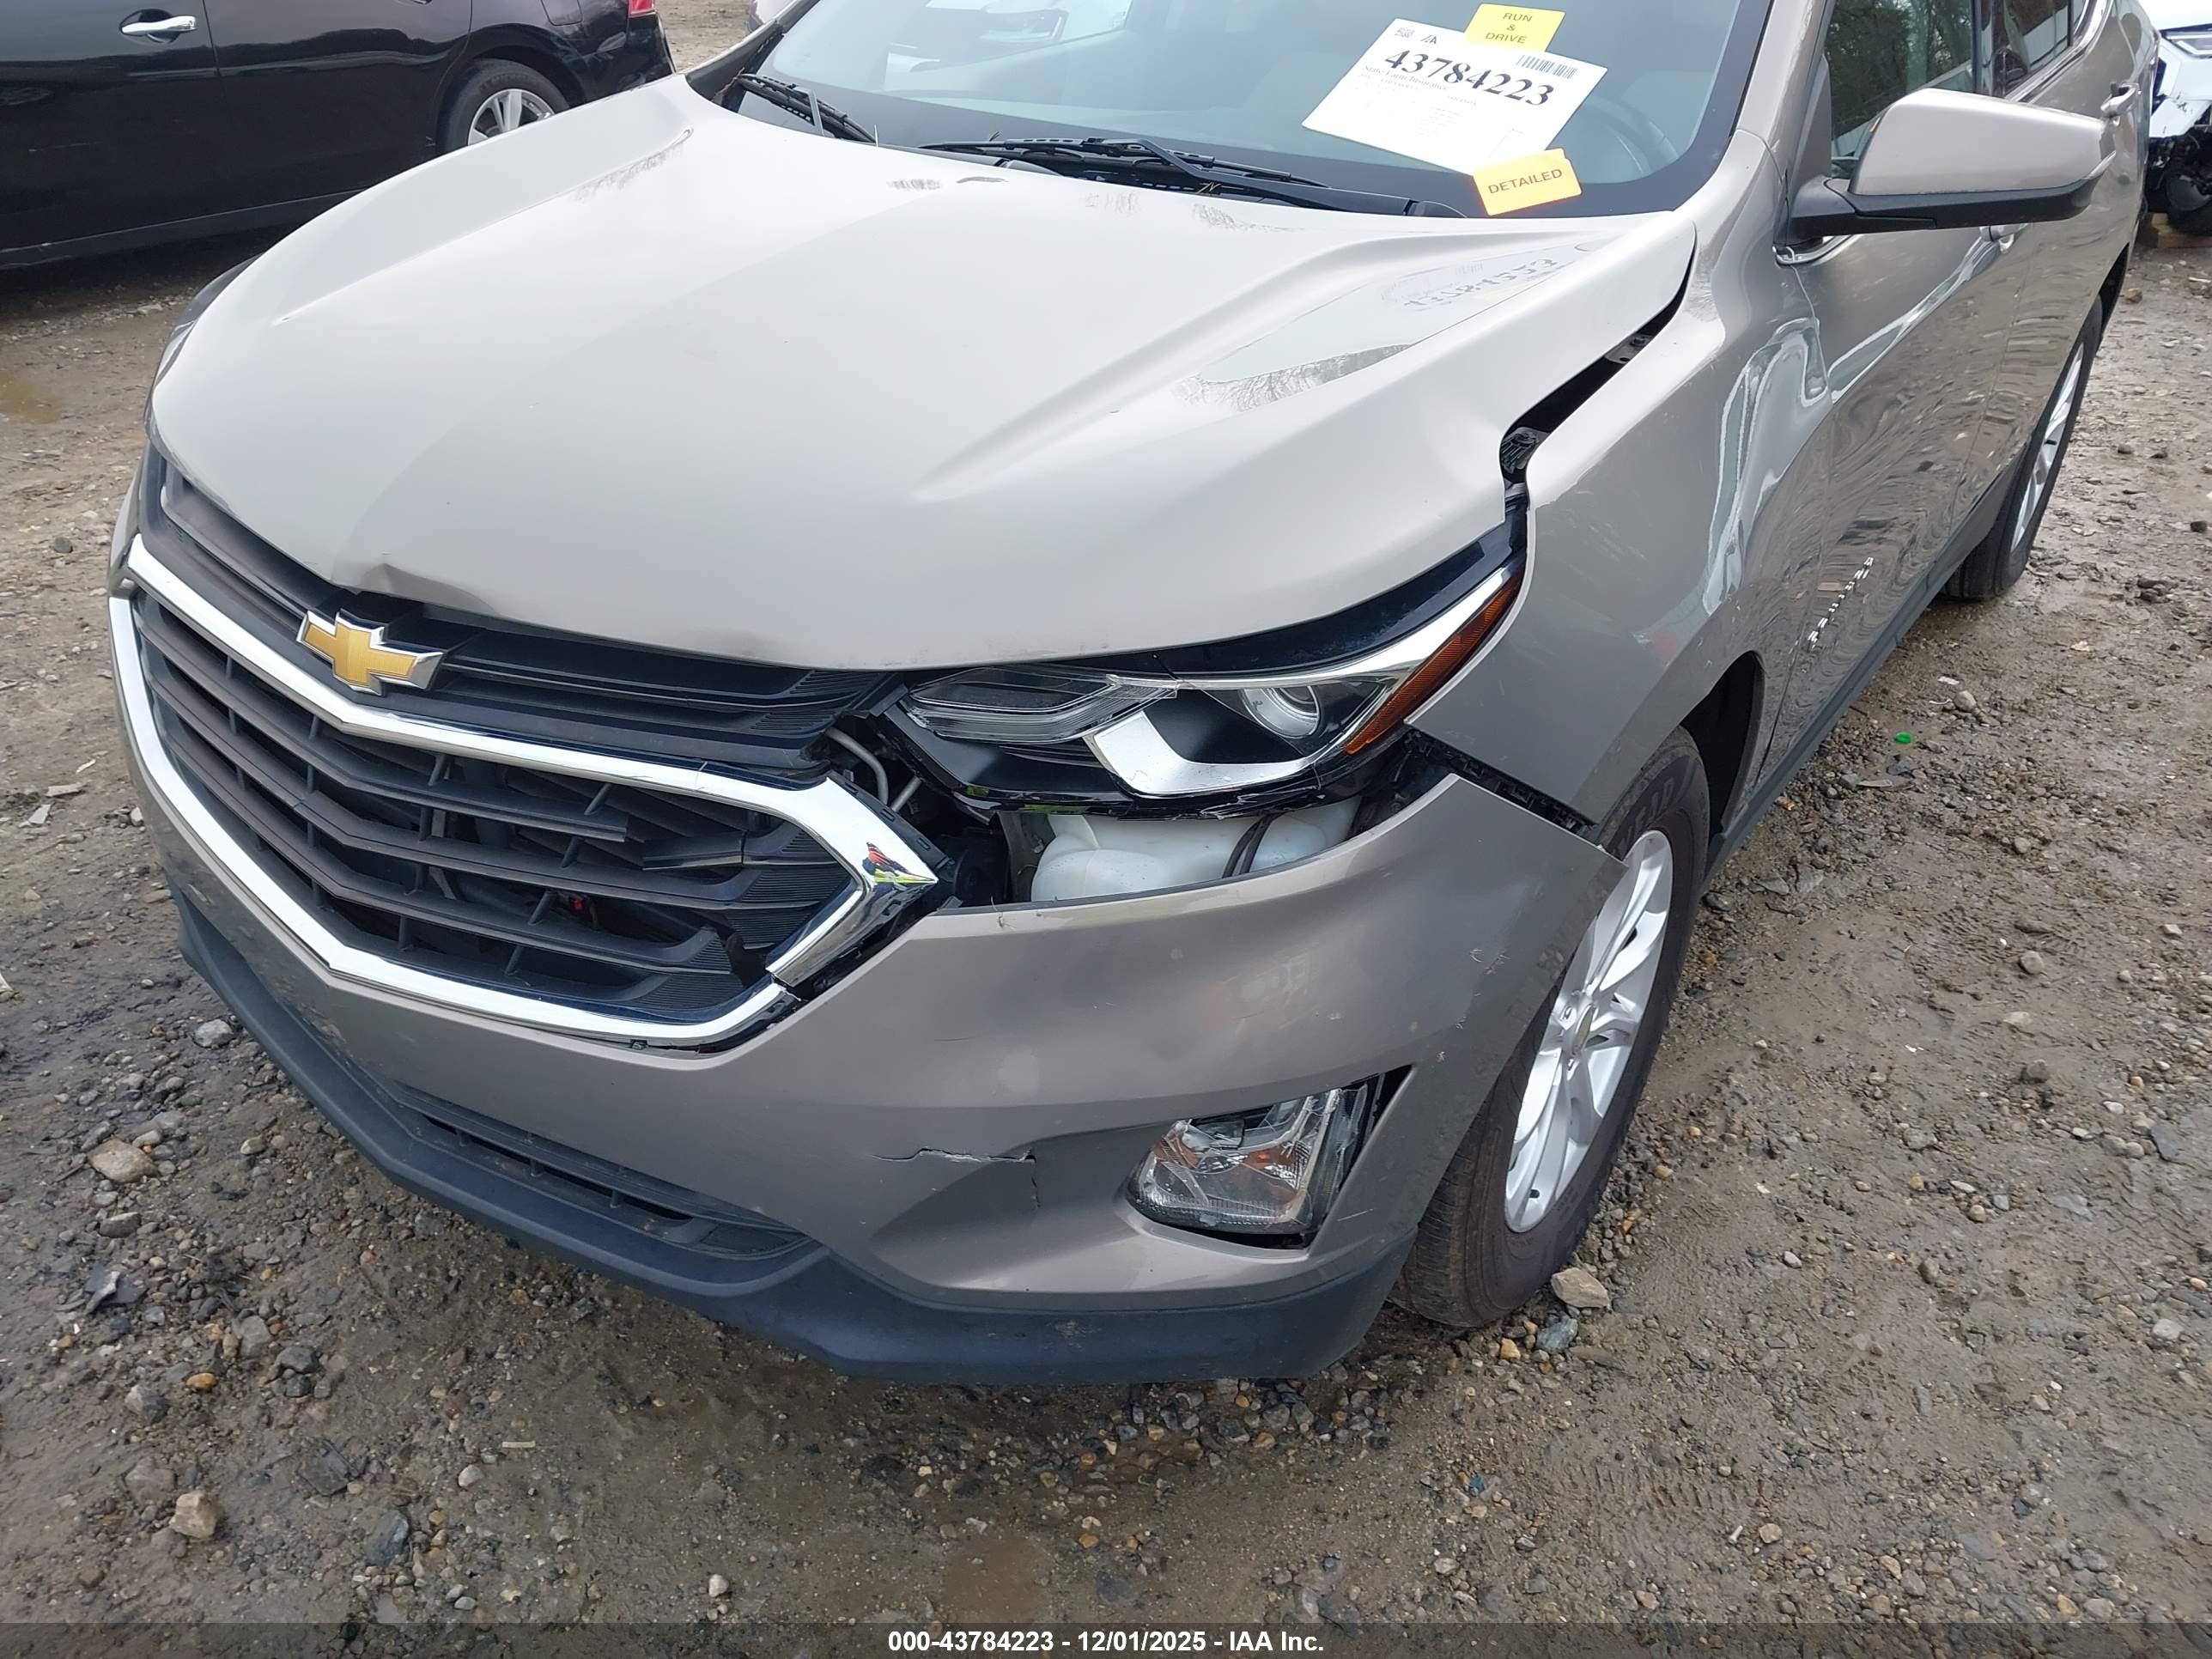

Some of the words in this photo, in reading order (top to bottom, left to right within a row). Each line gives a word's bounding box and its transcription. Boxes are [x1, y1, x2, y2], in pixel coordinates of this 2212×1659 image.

[1503, 12, 1533, 22] RUN
[1485, 32, 1528, 44] DRIVE
[1384, 50, 1554, 106] 43784223
[1488, 168, 1563, 195] DETAILED
